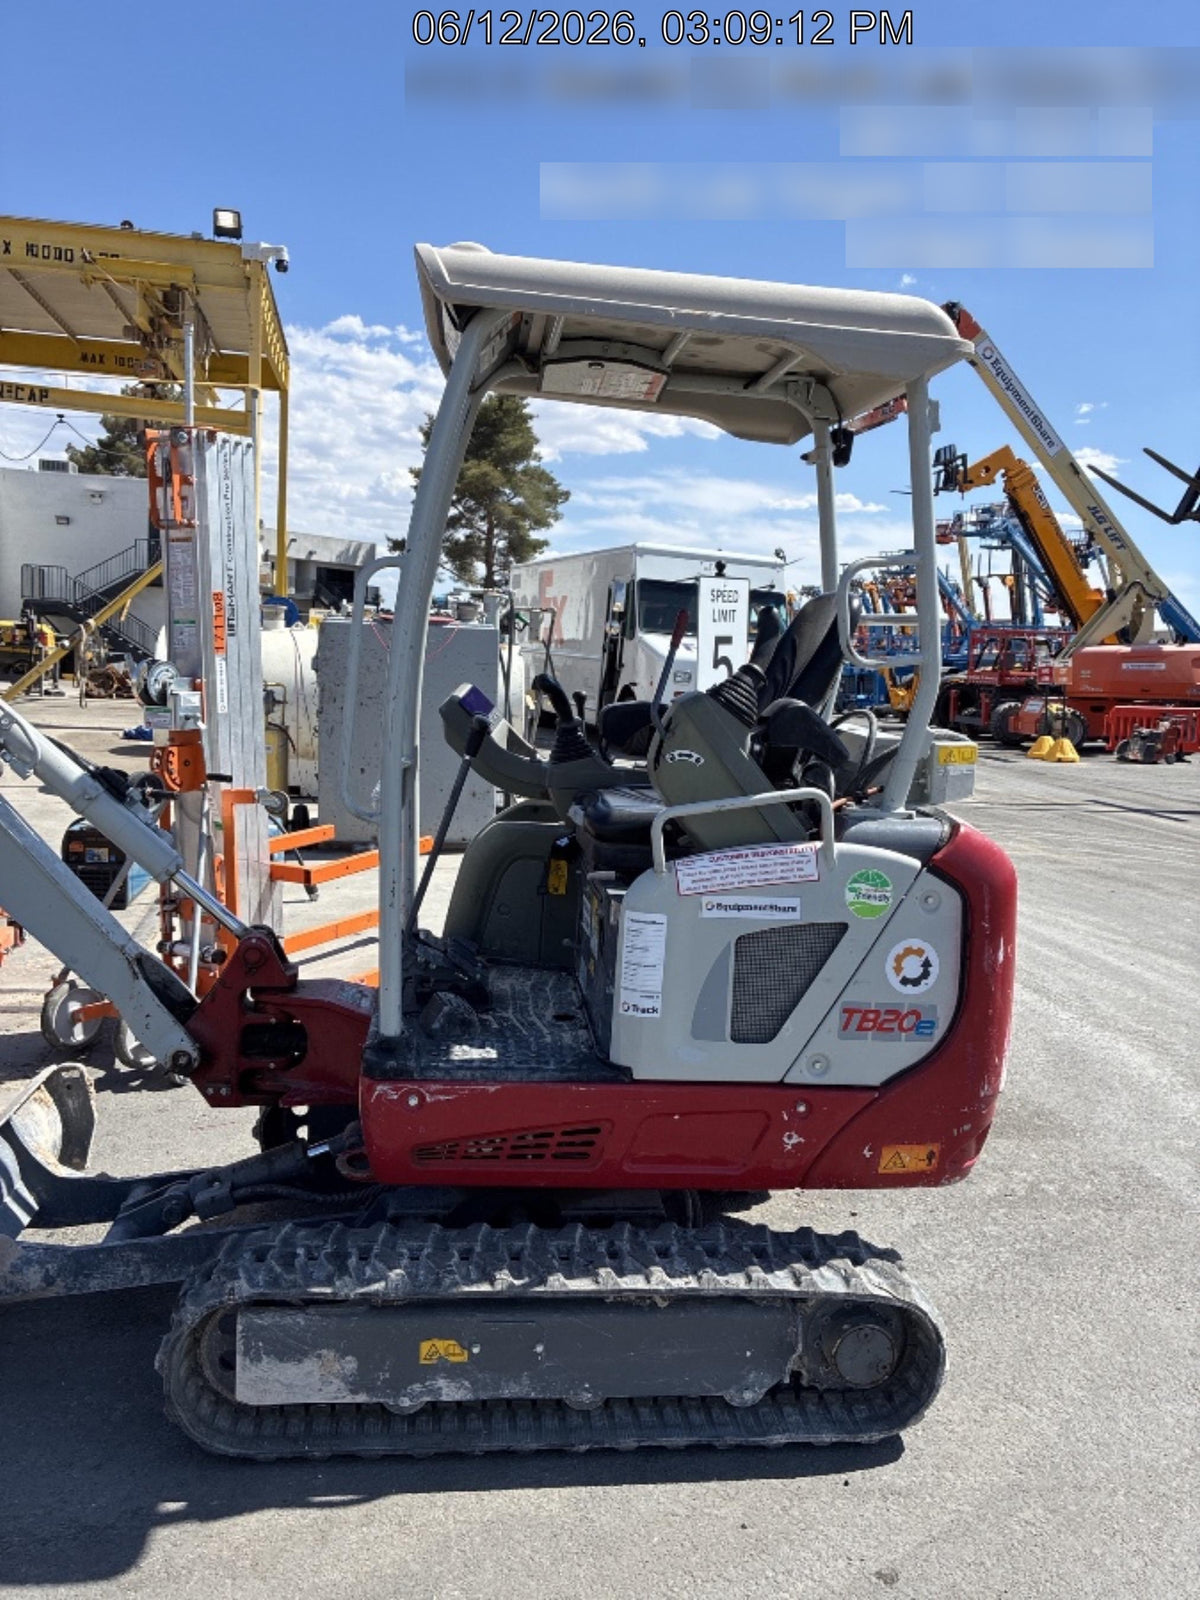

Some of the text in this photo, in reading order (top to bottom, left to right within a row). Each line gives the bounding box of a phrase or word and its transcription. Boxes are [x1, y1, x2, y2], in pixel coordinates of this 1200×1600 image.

[80, 351, 105, 365] MAX
[710, 589, 738, 603] SPEED
[712, 609, 737, 623] LIMIT
[712, 635, 733, 680] 5
[716, 902, 798, 913] EquipmentShare
[631, 1003, 659, 1014] Track
